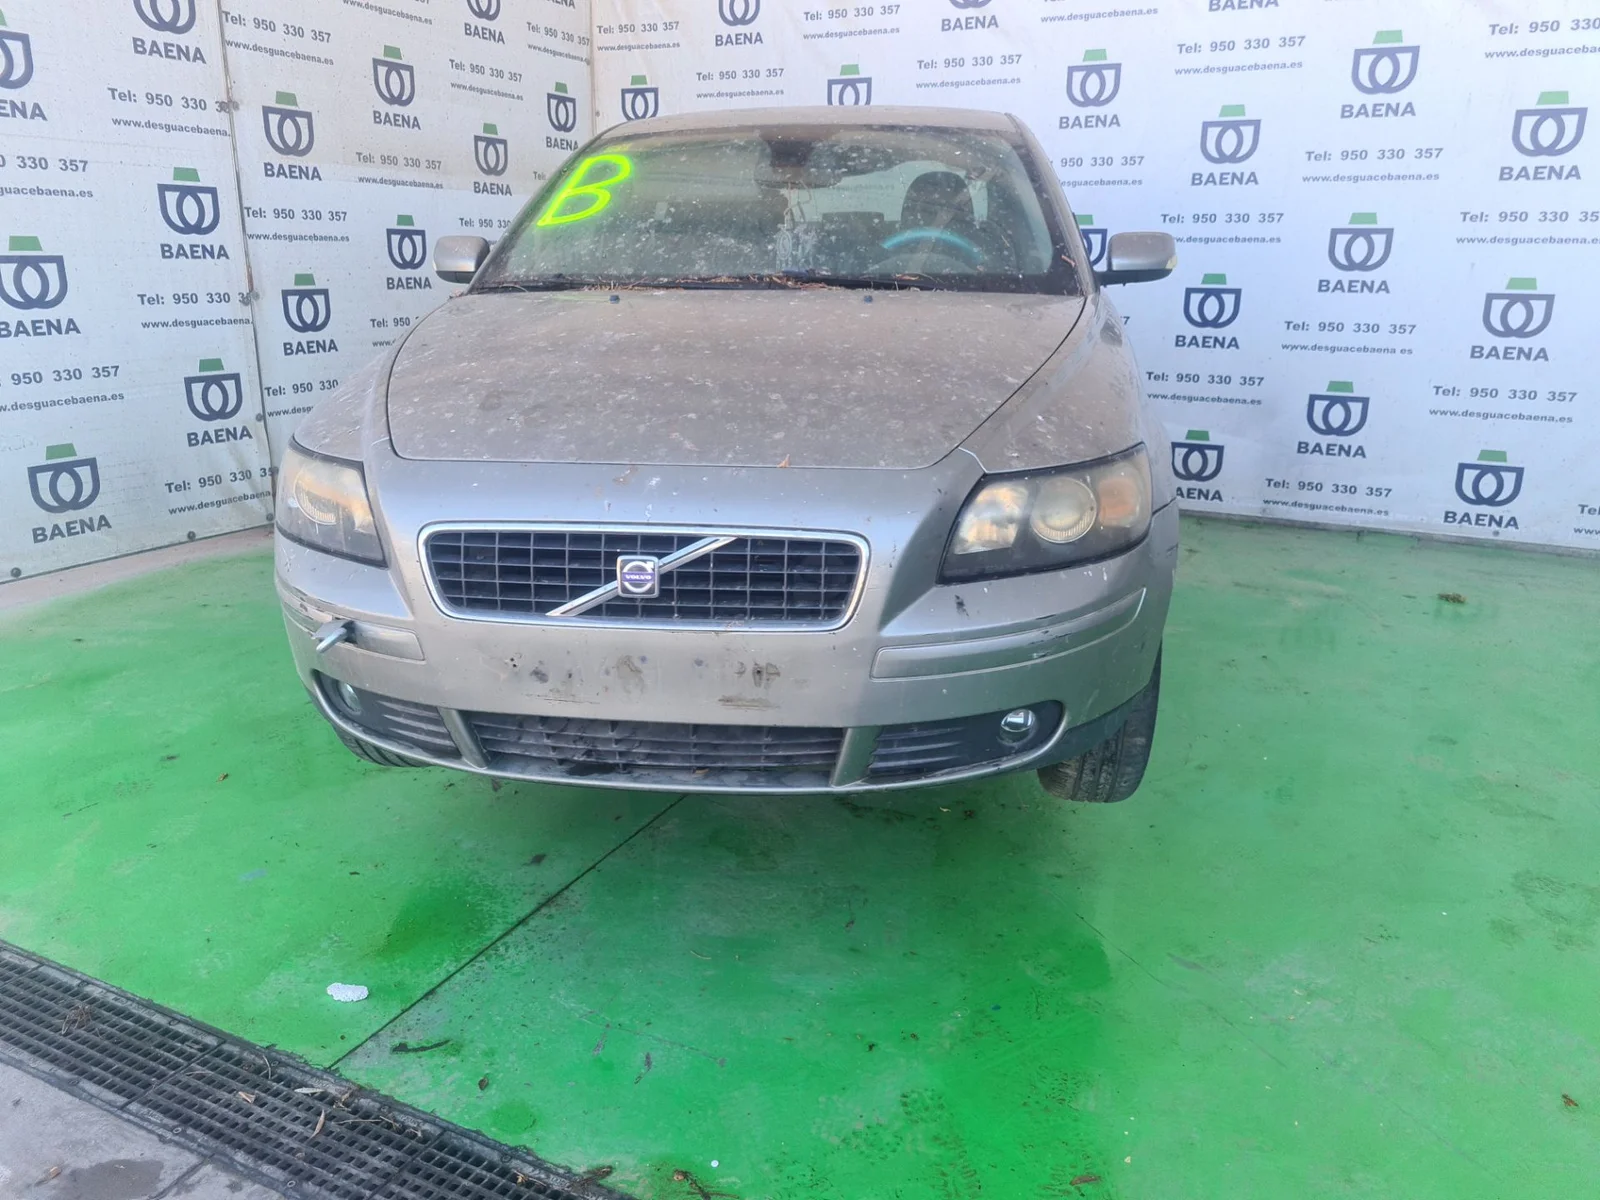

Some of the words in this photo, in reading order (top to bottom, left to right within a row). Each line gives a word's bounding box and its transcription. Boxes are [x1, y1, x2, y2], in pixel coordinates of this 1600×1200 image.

[804, 11, 822, 22] Tel:
[828, 9, 848, 19] 950
[854, 7, 874, 17] 330
[880, 5, 900, 15] 357
[1040, 8, 1158, 23] www.desguacebaena.es
[222, 10, 246, 26] Tel:
[253, 18, 276, 32] 950
[283, 23, 304, 38] 330
[311, 29, 331, 43] 357
[597, 24, 614, 34] Tel:
[618, 24, 636, 33] 950
[641, 23, 658, 32] 330
[663, 21, 680, 30] 357
[942, 15, 999, 32] BAENA
[1489, 23, 1519, 36] Tel:
[1528, 20, 1560, 33] 950
[1570, 18, 1600, 31] 330
[464, 23, 505, 44] BAENA
[527, 22, 540, 33] Tel:
[544, 27, 557, 38] 950
[562, 32, 574, 43] 330
[578, 36, 590, 46] 357
[715, 32, 763, 47] BAENA
[803, 26, 900, 40] www.desguacebaena.es
[132, 37, 206, 64] BAENA
[225, 39, 334, 66] www.desguacebaena.es
[597, 41, 680, 51] www.desguacebaena.es
[1178, 43, 1202, 54] Tel:
[1210, 40, 1235, 52] 950
[1244, 38, 1270, 50] 330
[1279, 36, 1306, 48] 357
[917, 60, 937, 70] Tel:
[944, 58, 965, 68] 950
[972, 56, 993, 66] 330
[1000, 54, 1021, 64] 357
[1175, 60, 1303, 75] www.desguacebaena.es
[449, 59, 465, 72] Tel:
[470, 63, 485, 75] 950
[489, 67, 504, 79] 330
[508, 72, 522, 83] 357
[696, 72, 714, 81] Tel:
[719, 71, 737, 80] 950
[742, 70, 760, 78] 330
[766, 69, 784, 78] 357
[451, 81, 523, 101] www.desguacebaena.es
[916, 77, 1021, 89] www.desguacebaena.es
[107, 87, 137, 103] Tel:
[145, 92, 173, 107] 950
[181, 96, 207, 111] 330
[696, 88, 784, 99] www.desguacebaena.es
[1340, 102, 1416, 119] BAENA
[373, 111, 421, 130] BAENA
[1059, 114, 1120, 130] BAENA
[546, 136, 578, 151] BAENA
[356, 152, 375, 163] Tel:
[380, 155, 398, 166] 950
[403, 158, 420, 168] 330
[426, 159, 441, 170] 357
[1061, 158, 1083, 168] 950
[1090, 156, 1113, 166] 330
[1121, 156, 1144, 166] 357
[1306, 150, 1332, 162] Tel:
[1340, 150, 1368, 160] 950
[1377, 149, 1405, 160] 330
[1414, 148, 1443, 159] 357
[16, 156, 48, 170] 330
[58, 158, 88, 172] 357
[264, 162, 322, 181] BAENA
[1191, 172, 1259, 186] BAENA
[1302, 173, 1439, 184] www.desguacebaena.es
[1499, 165, 1582, 181] BAENA
[358, 175, 443, 189] www.desguacebaena.es
[474, 182, 512, 196] BAENA
[537, 154, 632, 226] B
[1059, 178, 1143, 188] esguacebaena.es
[244, 207, 266, 218] Tel:
[273, 209, 295, 219] 950
[302, 210, 322, 220] 330
[328, 211, 347, 221] 357
[1161, 213, 1184, 223] Tel:
[1192, 213, 1217, 223] 950
[1225, 213, 1250, 223] 330
[1258, 213, 1284, 223] 357
[1460, 211, 1488, 222] Tel:
[1498, 211, 1528, 222] 950
[1538, 211, 1569, 222] 330
[1579, 211, 1600, 222] 35
[459, 218, 474, 227] Tel:
[479, 219, 493, 228] 950
[247, 232, 350, 242] www.desguacebaena.es
[160, 243, 229, 259] BAENA
[386, 277, 432, 290] BAENA
[1318, 280, 1390, 294] BAENA
[137, 294, 164, 306] Tel:
[172, 293, 198, 305] 950
[206, 292, 230, 304] 330
[0, 318, 81, 338] BAENA
[370, 318, 388, 328] Tel:
[393, 317, 410, 327] 950
[1285, 321, 1309, 331] Tel:
[1318, 322, 1344, 332] 950
[1353, 323, 1380, 333] 330
[1388, 324, 1416, 334] 357
[283, 339, 338, 356] BAENA
[1175, 335, 1239, 349] BAENA
[1470, 345, 1549, 362] BAENA
[11, 372, 43, 385] 950
[52, 368, 82, 382] 330
[92, 366, 119, 378] 357
[1146, 372, 1168, 382] Tel:
[1176, 373, 1200, 384] 950
[1207, 374, 1232, 385] 330
[1239, 376, 1264, 386] 357
[264, 386, 286, 397] Tel:
[293, 382, 313, 394] 950
[1433, 385, 1460, 397] Tel:
[1469, 388, 1498, 398] 950
[1508, 389, 1537, 400] 330
[1547, 392, 1577, 402] 357
[1147, 392, 1262, 406] www.desguacebaena.es
[1429, 408, 1573, 423] www.desguacebaena.es
[187, 426, 253, 447] BAENA
[1297, 441, 1366, 459] BAENA
[165, 481, 190, 493] Tel:
[199, 474, 222, 488] 950
[230, 470, 252, 482] 330
[1266, 478, 1290, 489] Tel:
[1298, 481, 1323, 492] 950
[1332, 484, 1357, 494] 330
[1366, 486, 1392, 497] 357
[1263, 498, 1389, 517] www.desguacebaena.es
[32, 514, 112, 543] BAENA
[1443, 511, 1519, 530] BAENA
